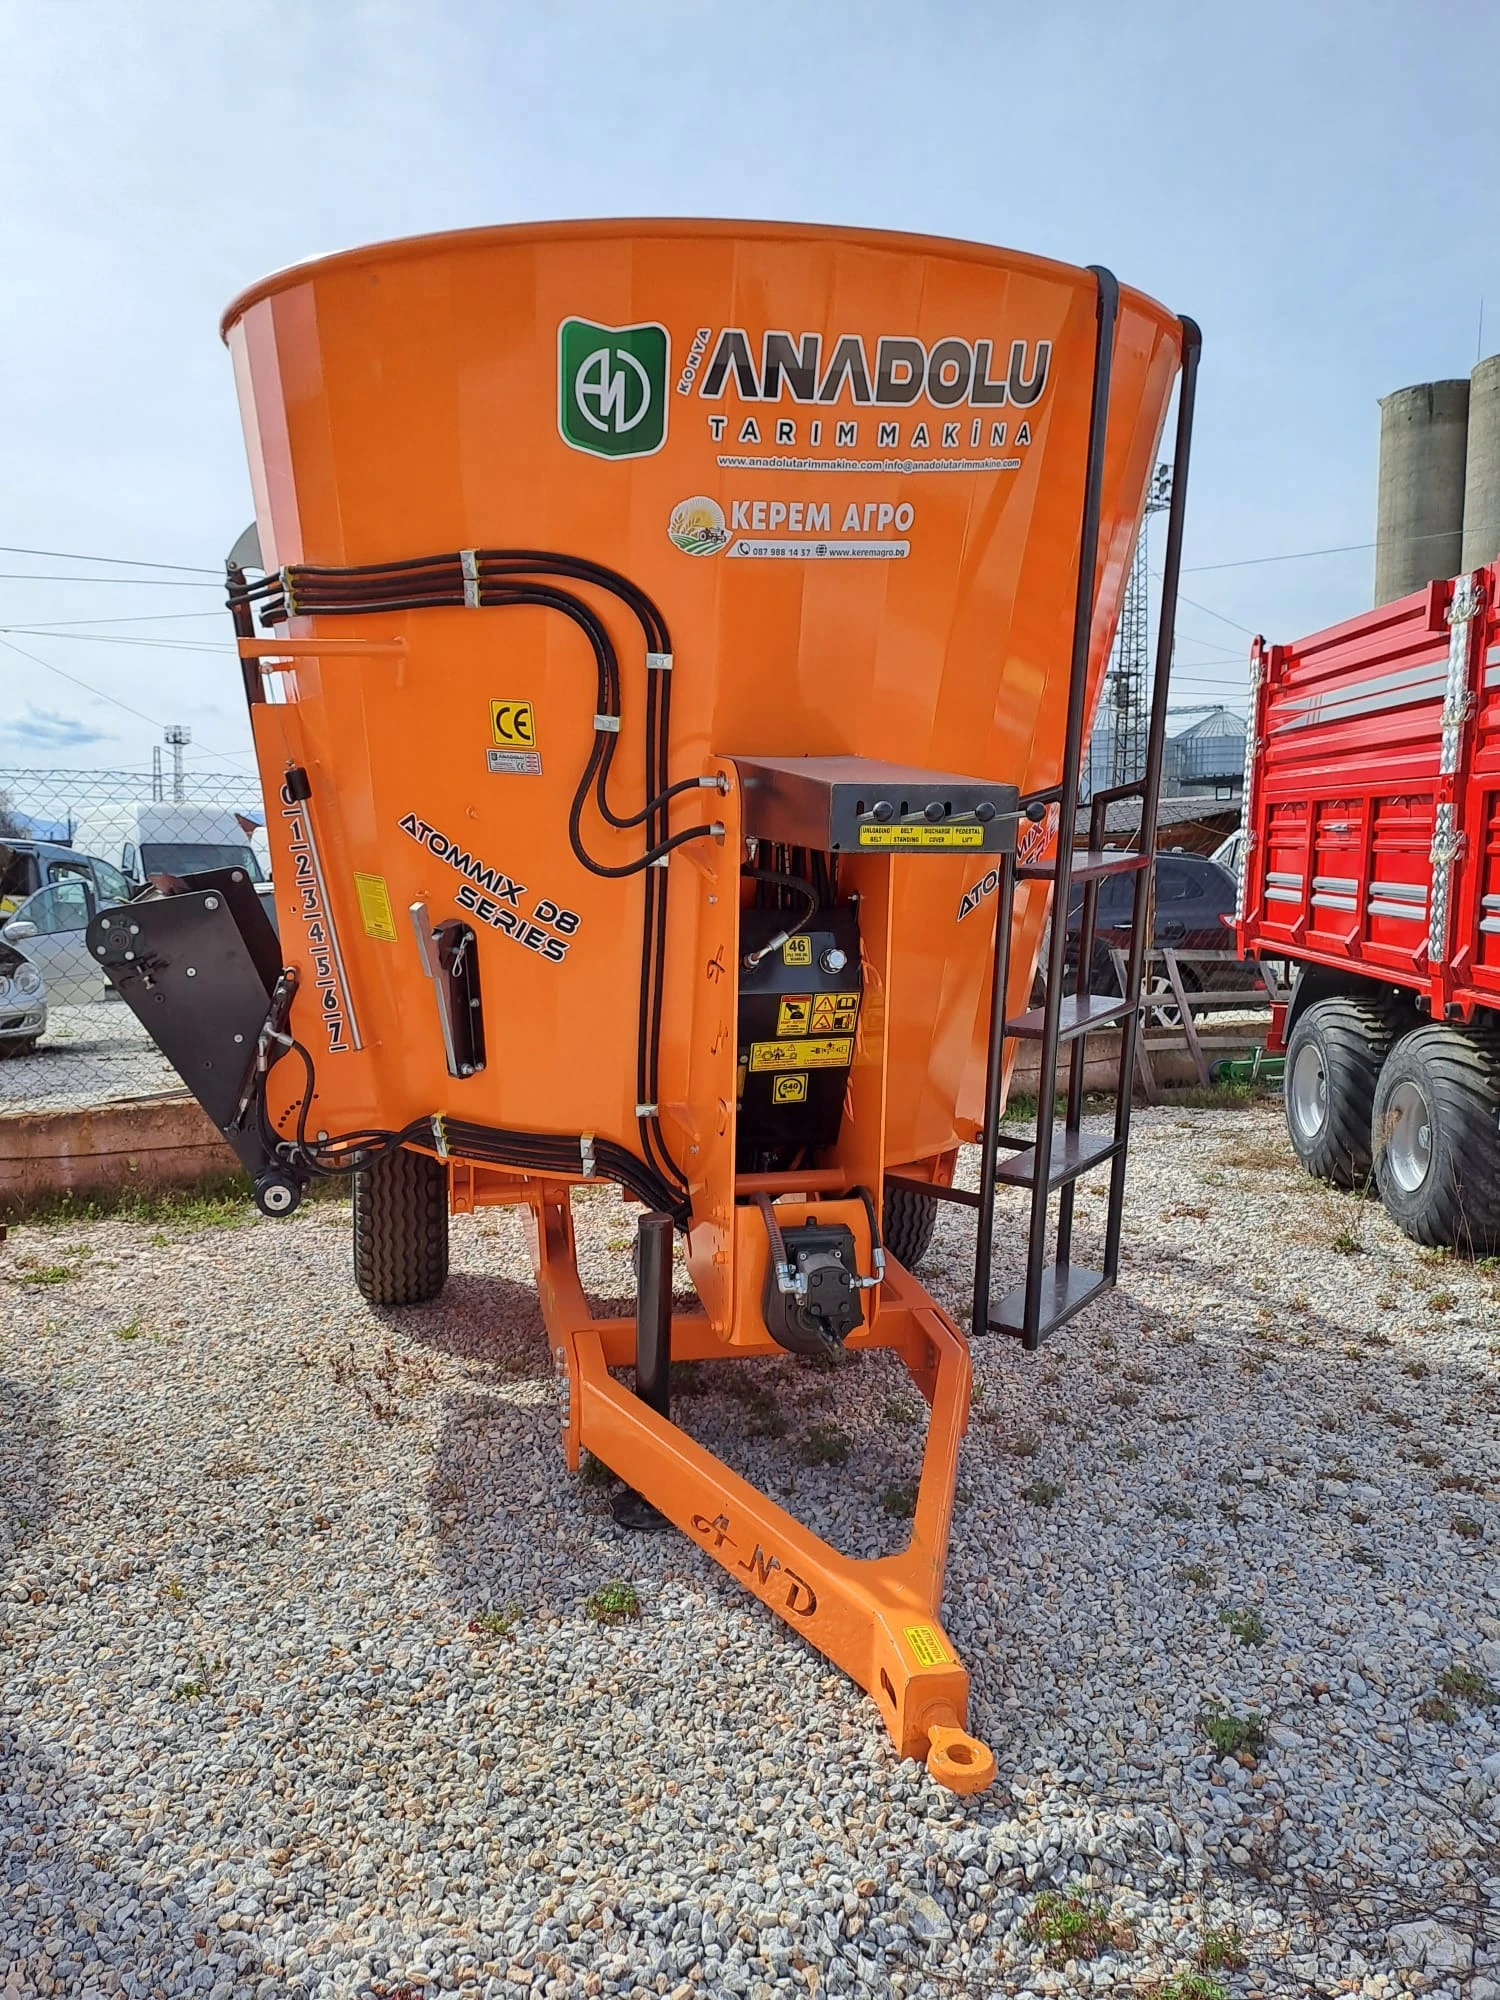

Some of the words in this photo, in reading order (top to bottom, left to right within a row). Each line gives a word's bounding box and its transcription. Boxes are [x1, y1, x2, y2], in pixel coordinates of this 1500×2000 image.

[678, 328, 711, 394] KONYA
[701, 330, 1051, 406] ANADOLU
[709, 417, 856, 445] TARIM
[718, 456, 882, 471] www.anadolutarimmakine.com
[731, 500, 832, 532] КЕРЕМ
[841, 501, 915, 533] АГРО
[800, 548, 811, 557] 37
[495, 706, 532, 741] CE
[291, 819, 302, 841] 1
[296, 855, 311, 875] 2
[399, 812, 527, 906] ATOMMIX
[533, 900, 581, 935] D8
[302, 888, 317, 909] 3
[309, 922, 324, 942] 4
[455, 885, 570, 963] SERIES
[788, 939, 806, 953] 46
[316, 956, 330, 976] 5
[323, 988, 337, 1010] 6
[328, 1021, 341, 1043] 7
[782, 1082, 799, 1091] 540
